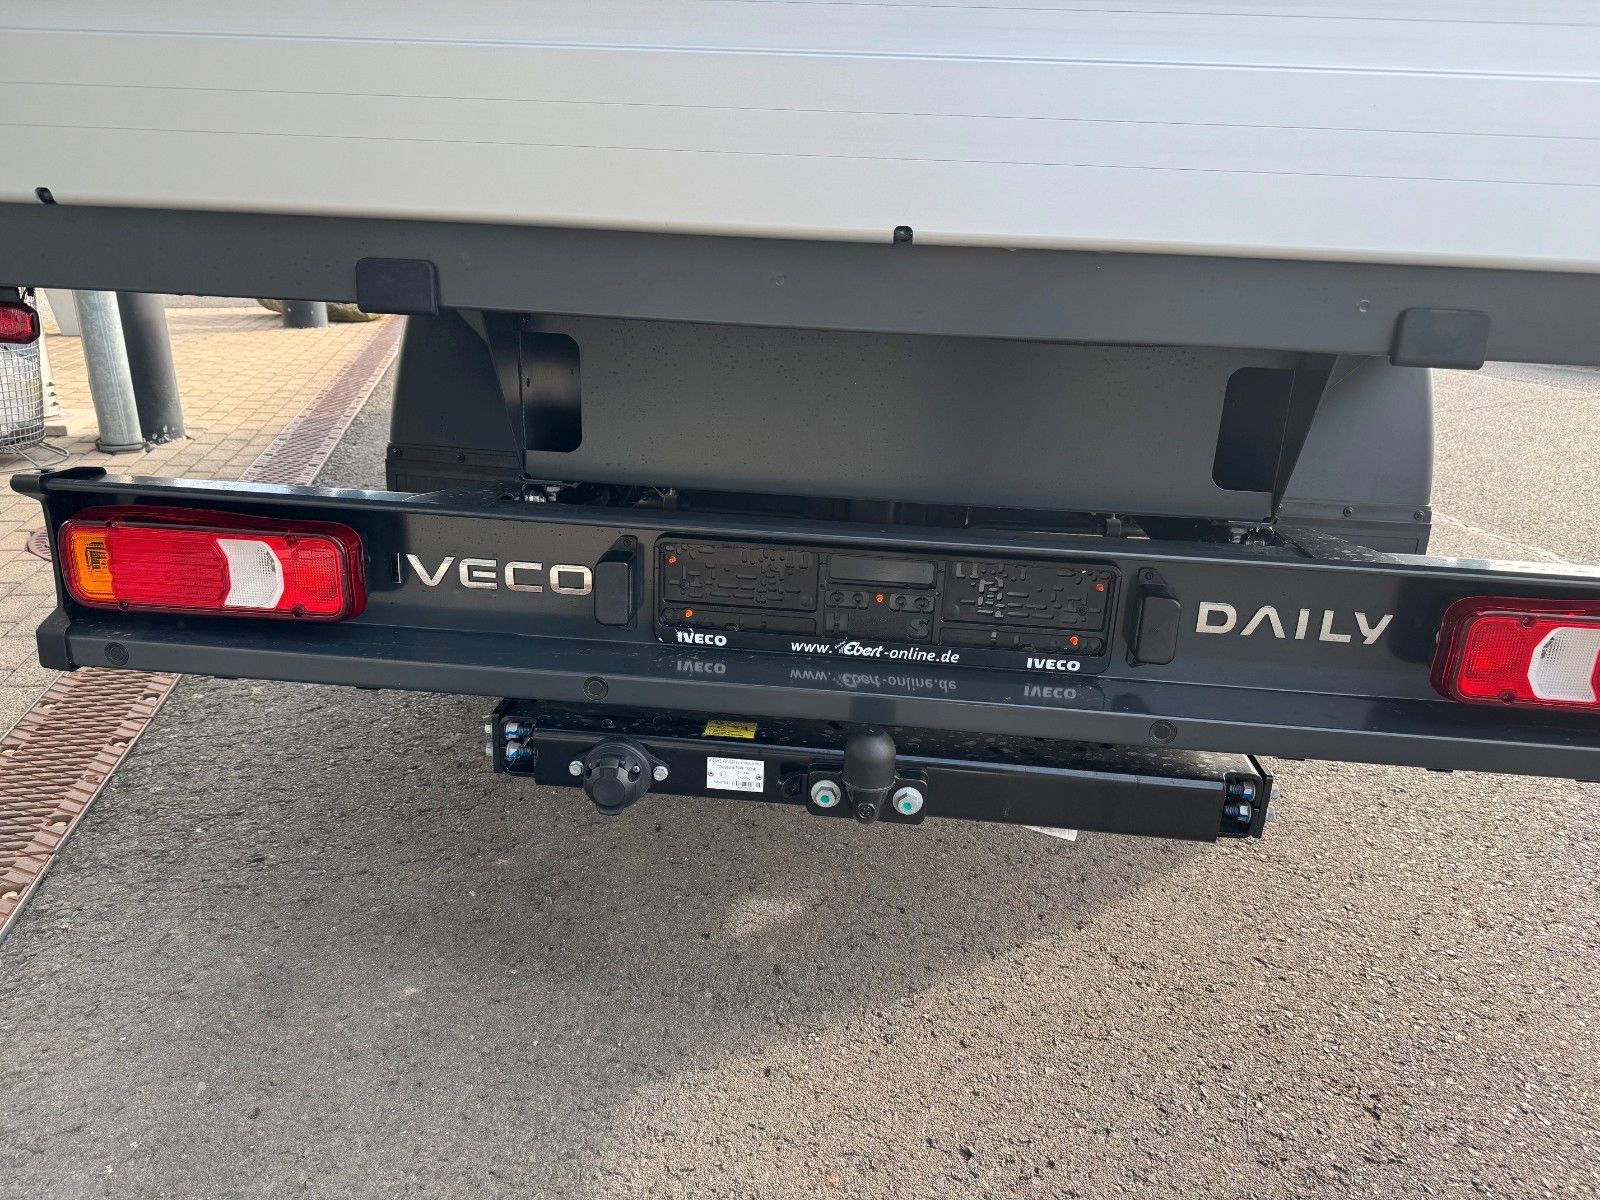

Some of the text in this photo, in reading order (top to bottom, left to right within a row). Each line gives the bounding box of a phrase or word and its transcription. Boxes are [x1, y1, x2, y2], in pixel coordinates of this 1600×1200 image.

[1195, 601, 1394, 645] DAILY
[676, 631, 727, 646] IVECO
[1026, 657, 1081, 672] IVECO
